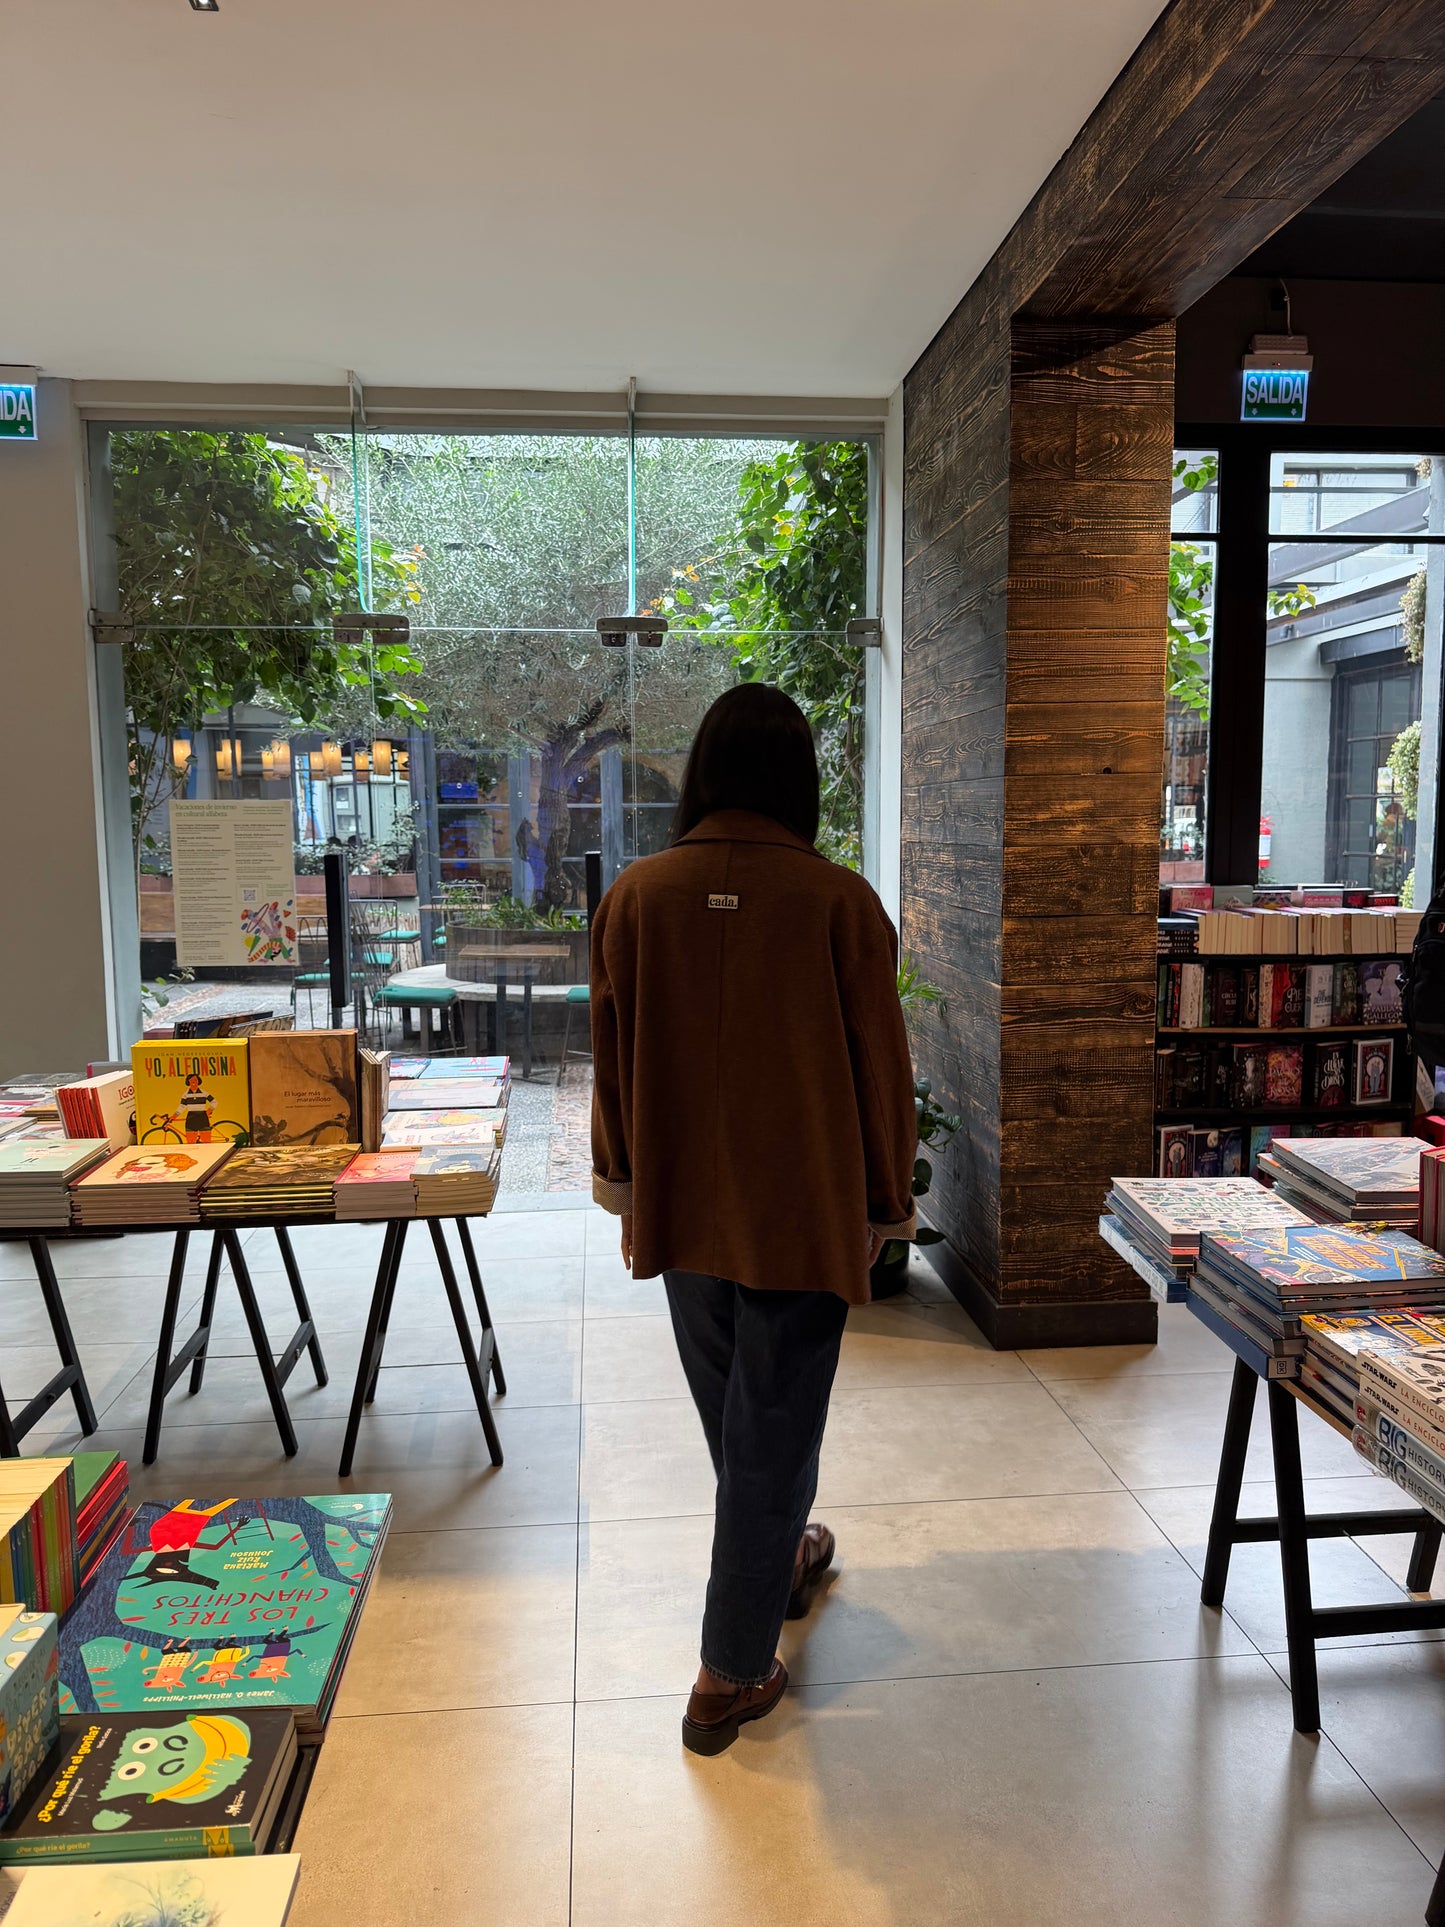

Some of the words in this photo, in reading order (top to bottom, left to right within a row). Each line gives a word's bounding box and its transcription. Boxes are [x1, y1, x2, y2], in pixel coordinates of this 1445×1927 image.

[1246, 376, 1303, 404] SALIDA
[145, 1057, 166, 1078] YO,
[168, 1056, 237, 1077] ALFONSINA
[1361, 1361, 1379, 1378] STAR
[1379, 1373, 1397, 1389] WARS
[1400, 1387, 1409, 1399] LA
[1364, 1386, 1382, 1403] STAR
[1381, 1399, 1400, 1415] WARS
[1402, 1414, 1411, 1426] LA
[1379, 1416, 1408, 1461] BIG
[1378, 1447, 1407, 1490] BIG
[167, 1610, 231, 1626] TRES
[246, 1606, 299, 1623] LOS
[77, 1725, 101, 1755] gorila?
[71, 1755, 84, 1765] el
[52, 1779, 70, 1798] qué
